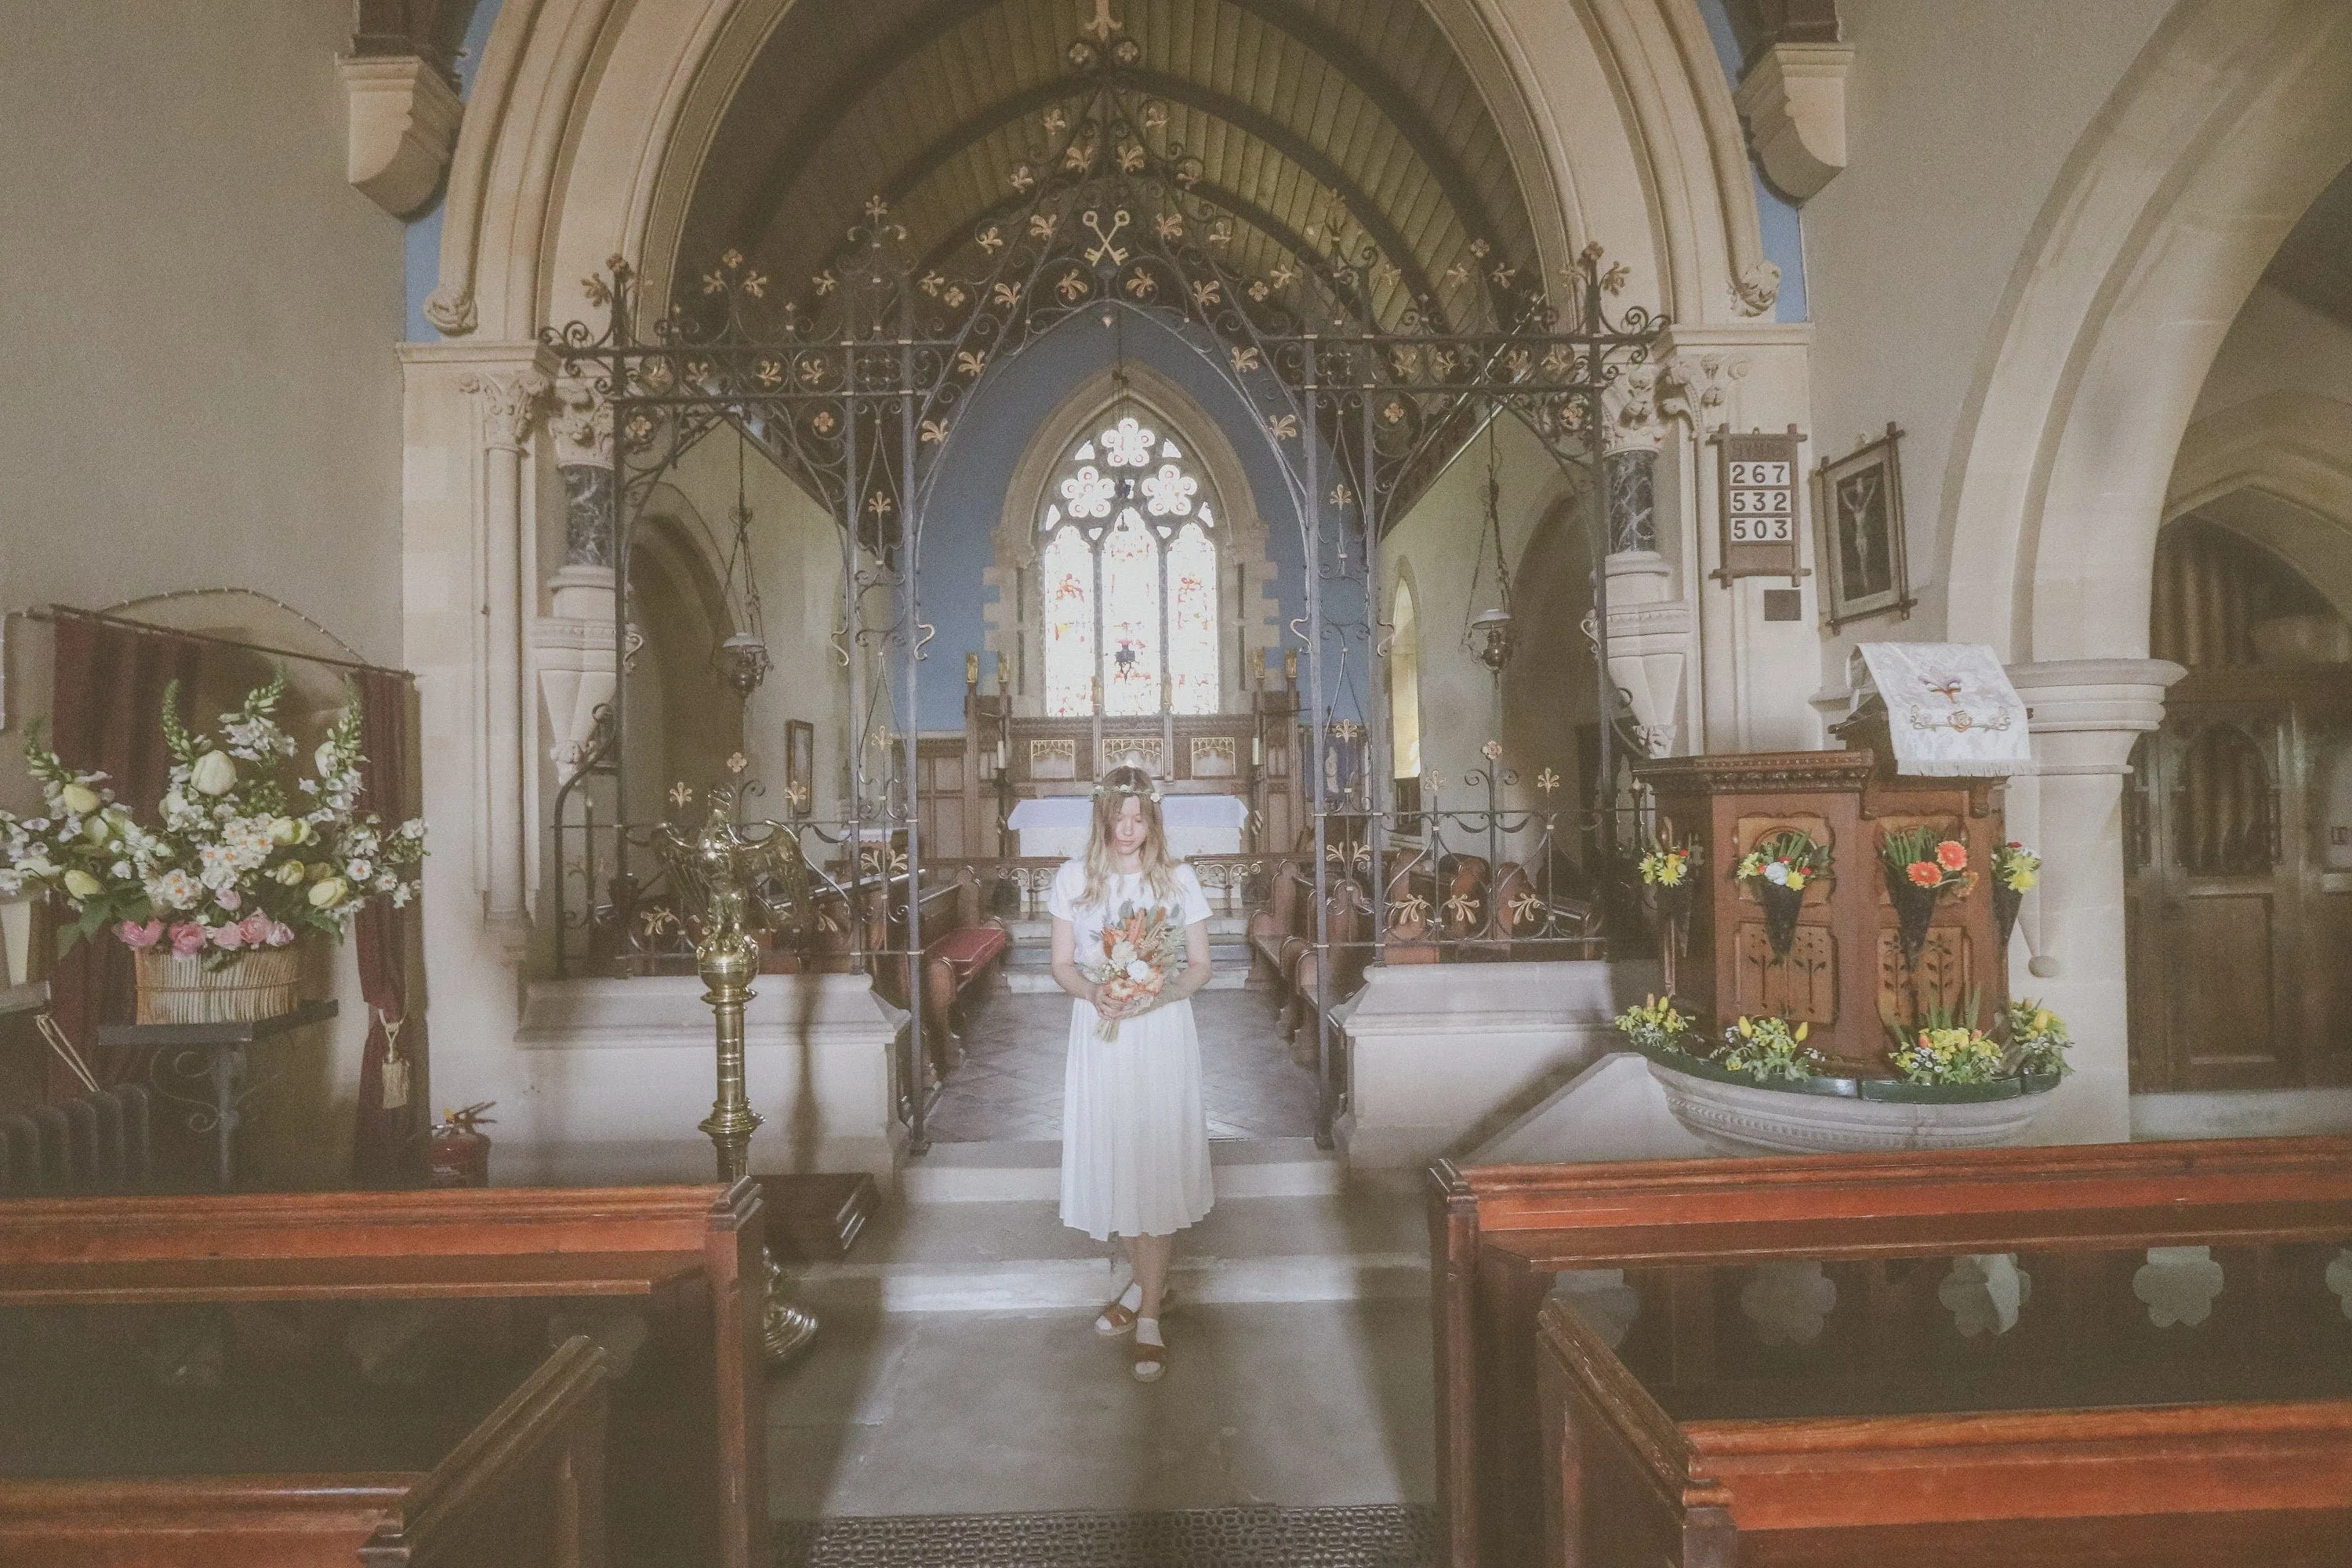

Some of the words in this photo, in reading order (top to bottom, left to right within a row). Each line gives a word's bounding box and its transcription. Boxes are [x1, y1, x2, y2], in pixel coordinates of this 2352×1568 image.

[1733, 464, 1785, 484] 267
[1733, 492, 1787, 512] 532
[1734, 519, 1788, 539] 503
